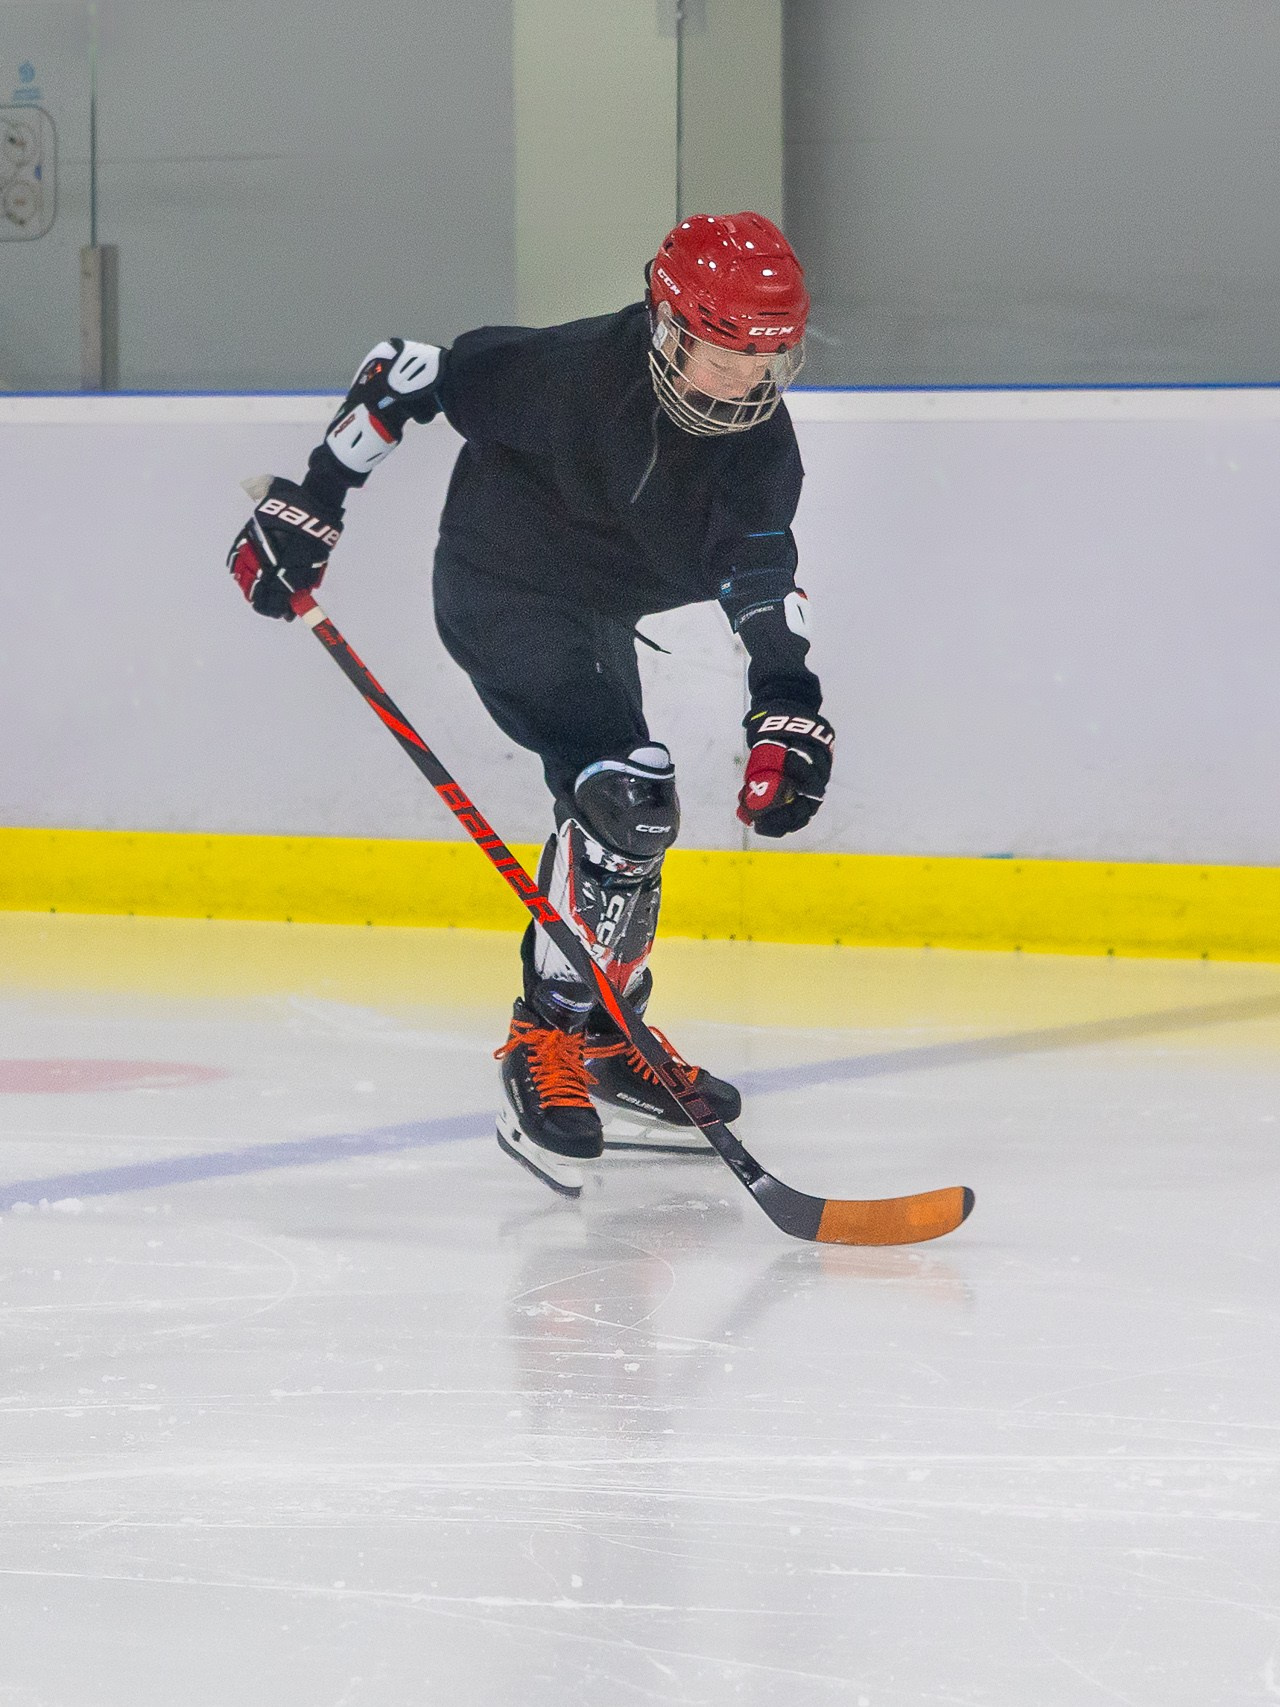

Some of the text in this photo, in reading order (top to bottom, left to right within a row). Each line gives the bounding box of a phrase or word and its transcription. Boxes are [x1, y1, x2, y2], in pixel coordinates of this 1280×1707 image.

[656, 268, 681, 296] CCM
[748, 326, 795, 336] CCM
[258, 498, 340, 548] BAUE
[757, 715, 834, 746] BAU
[435, 783, 562, 926] BAUER
